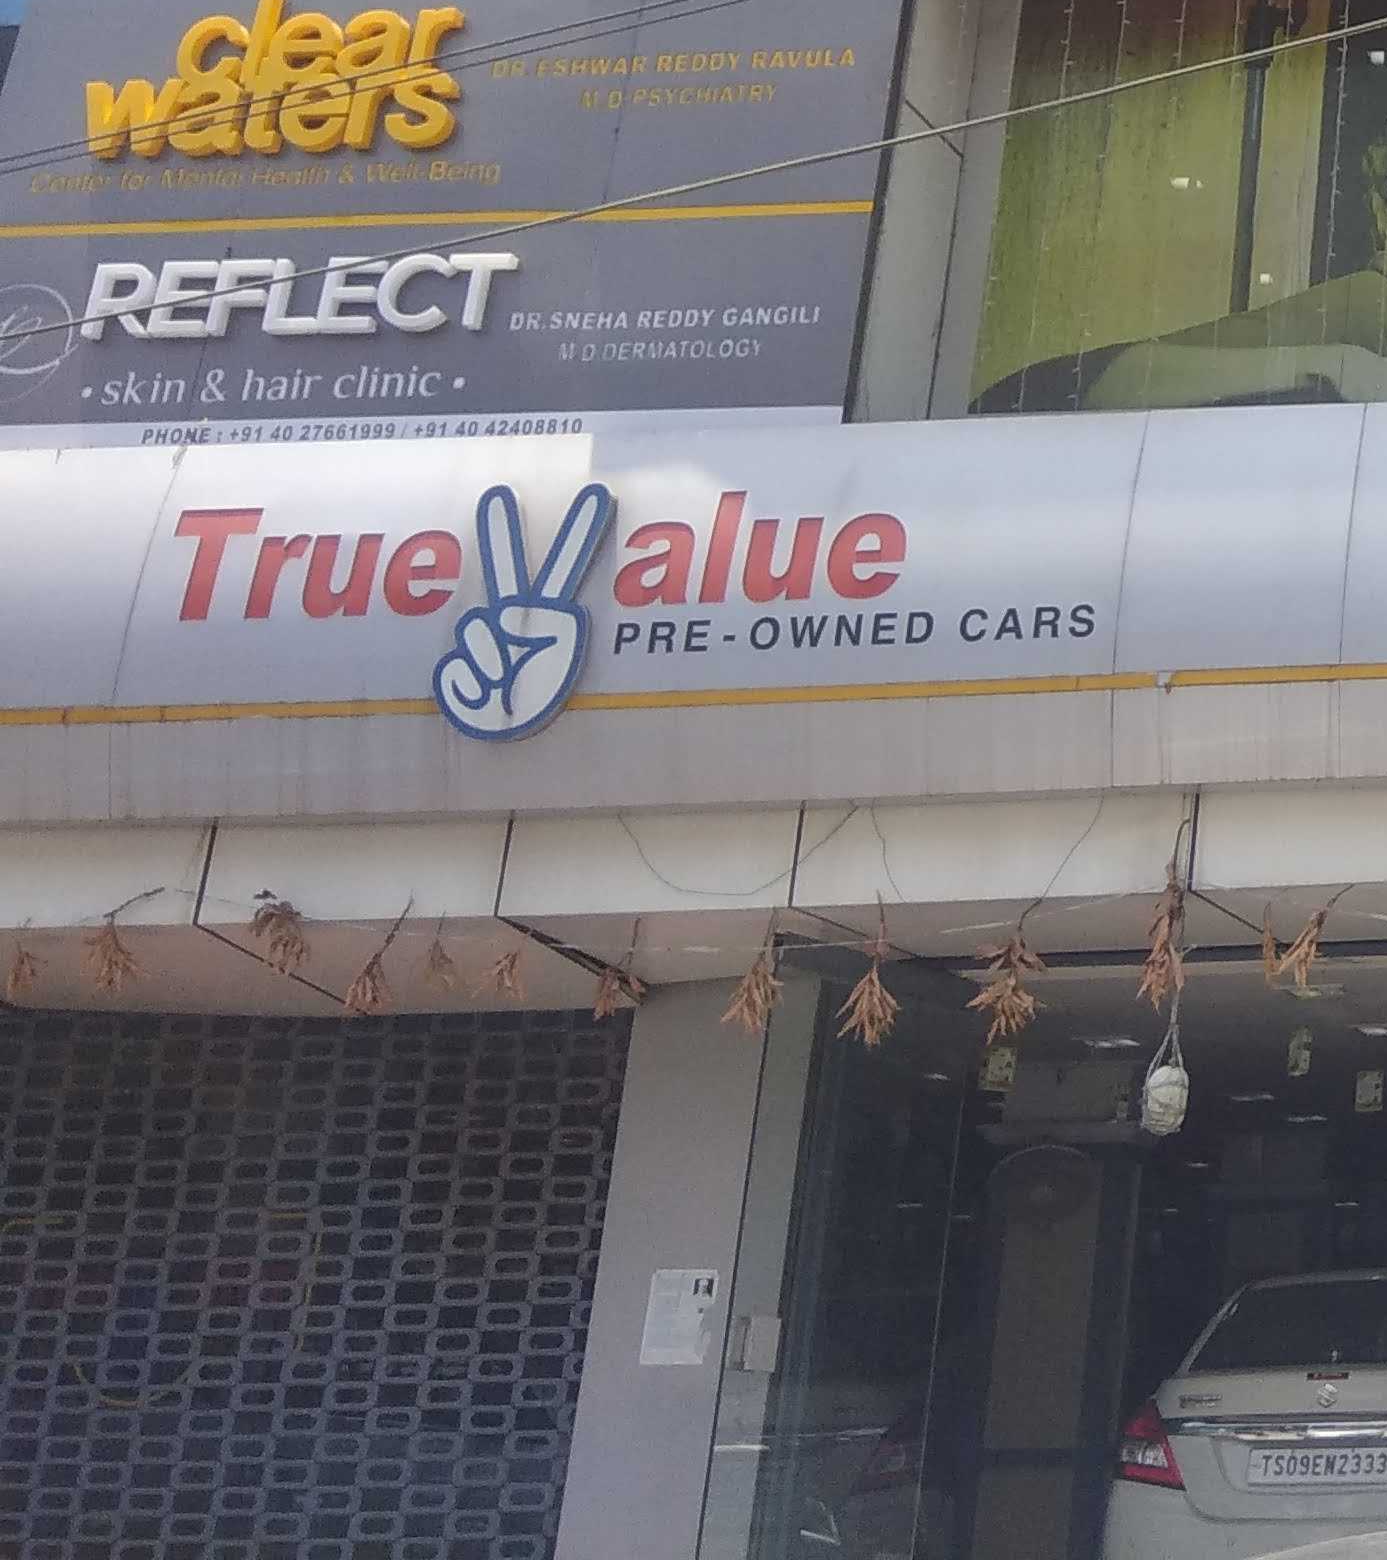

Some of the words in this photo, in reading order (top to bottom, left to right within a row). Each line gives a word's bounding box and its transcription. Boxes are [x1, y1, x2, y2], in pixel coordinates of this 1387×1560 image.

[534, 55, 648, 77] ESHWAR
[655, 51, 741, 73] REDDY
[750, 47, 856, 69] RAVULA
[632, 84, 778, 107] PSYCHIATRY
[86, 73, 462, 159] waters
[338, 163, 355, 184] &
[80, 252, 520, 340] REFLECT
[637, 308, 714, 329] REDDY
[723, 305, 821, 327] GANGILI
[603, 339, 762, 362] DERMATOLOGY
[100, 370, 186, 406] skin
[200, 368, 227, 404] &
[241, 367, 323, 402] hair
[333, 364, 442, 400] clinic
[229, 426, 265, 443] +91
[270, 425, 293, 442] 40
[298, 423, 396, 441] 27661999
[414, 422, 449, 439] +91
[455, 420, 478, 437] 40
[485, 418, 584, 437] 42408810
[172, 507, 463, 622] True
[958, 604, 1097, 643] CARS
